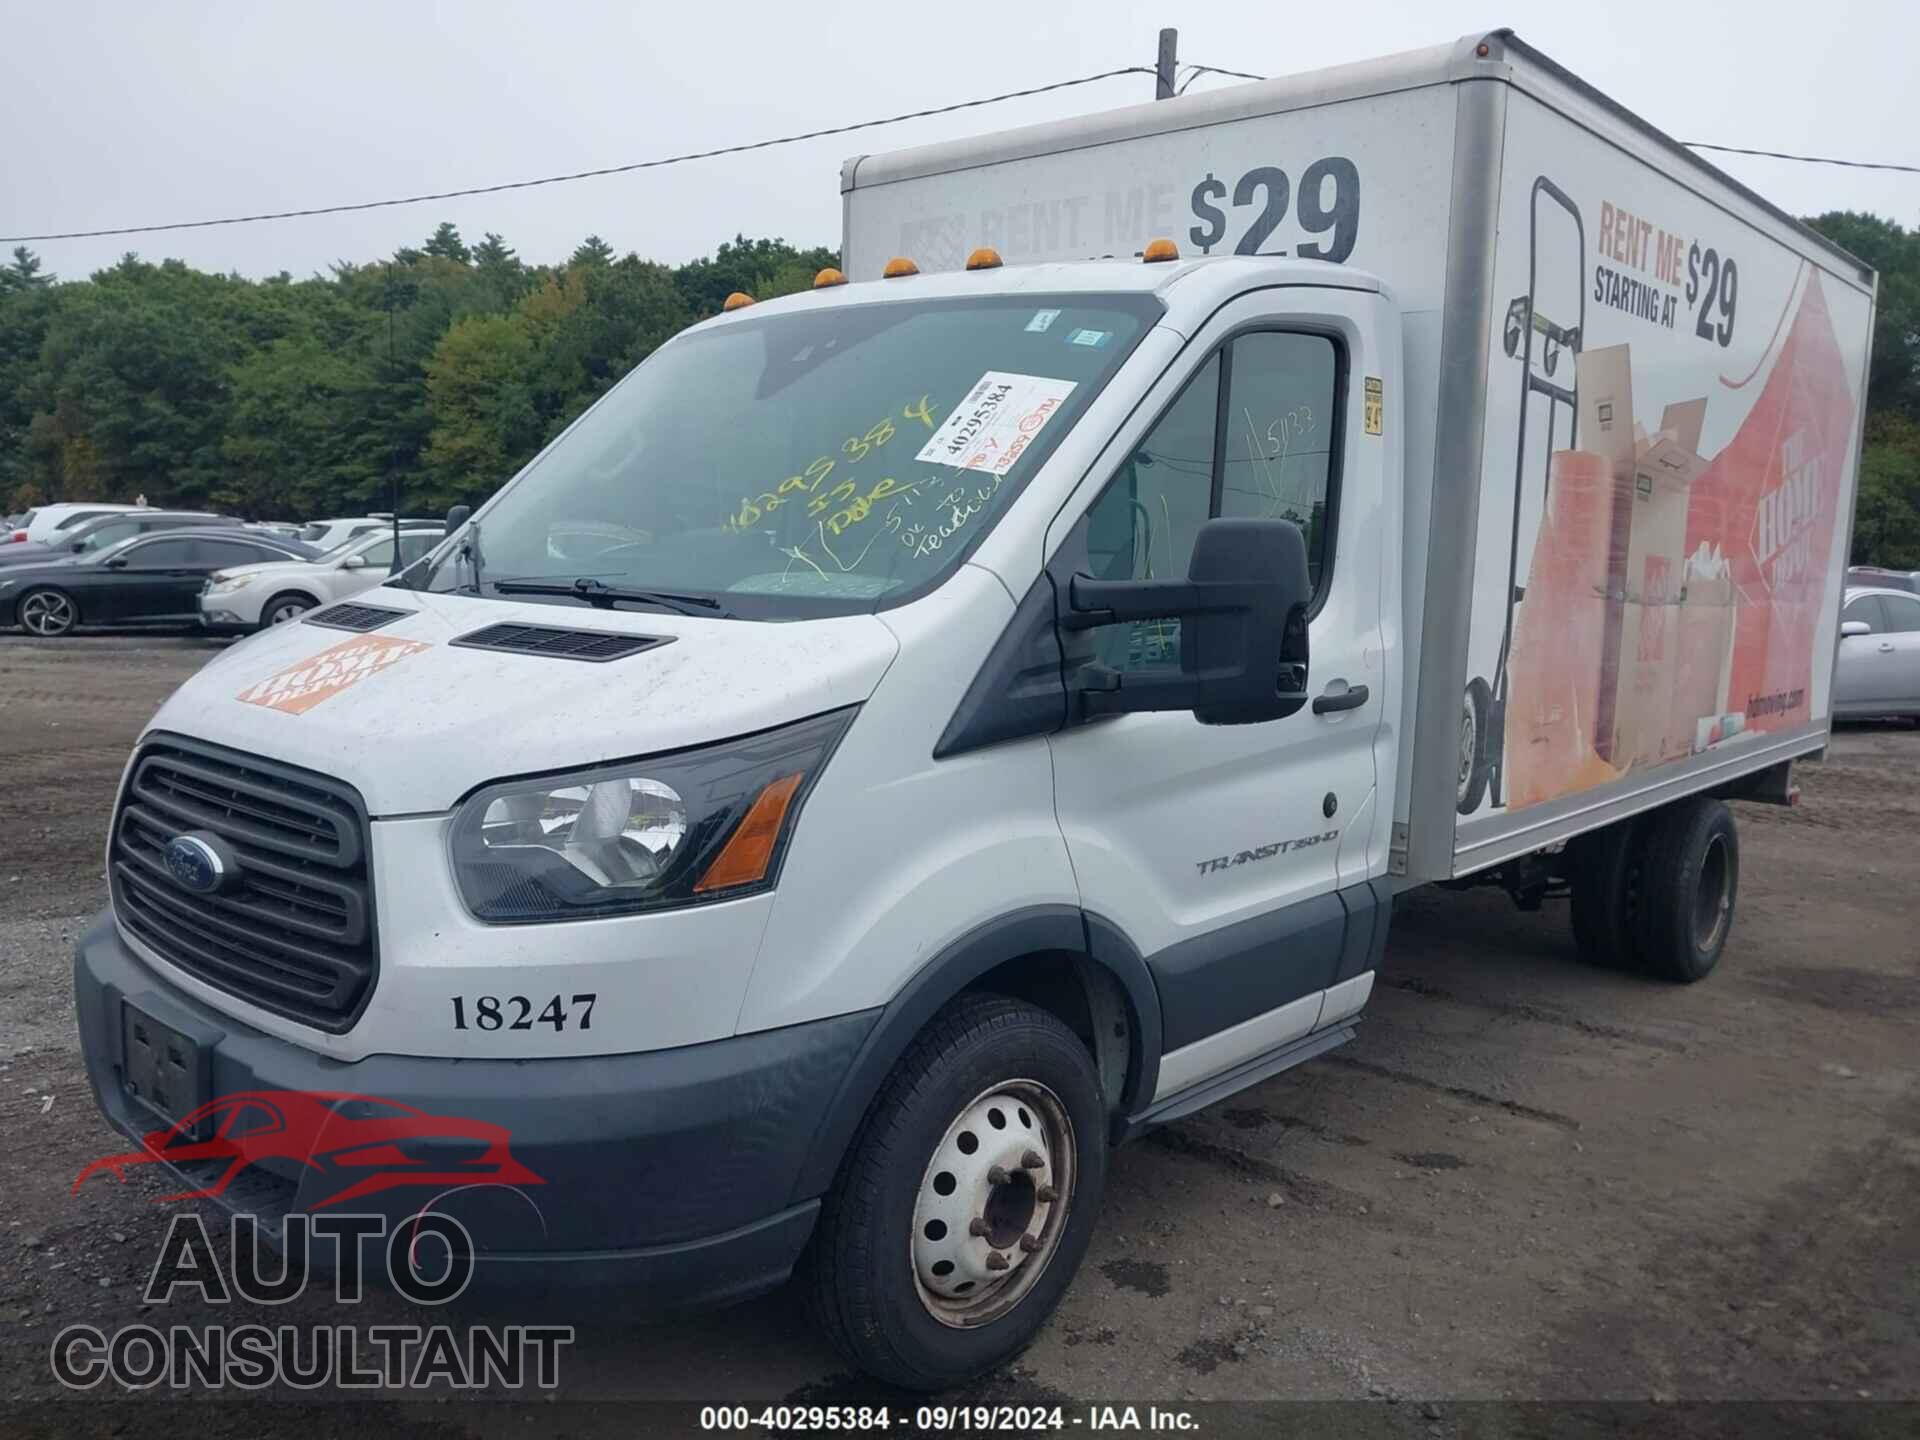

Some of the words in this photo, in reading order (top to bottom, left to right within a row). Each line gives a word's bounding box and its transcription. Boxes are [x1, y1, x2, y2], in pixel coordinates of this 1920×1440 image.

[1104, 183, 1178, 244] ME
[1189, 156, 1361, 265] $29
[1598, 200, 1653, 272] RENT
[1655, 229, 1684, 287] ME
[1594, 265, 1659, 324] STARTING
[1661, 295, 1678, 329] AT
[1686, 238, 1738, 348] $29
[947, 384, 1013, 455] 40295384
[1196, 839, 1294, 876] TRANSIT
[451, 993, 597, 1032] 18247
